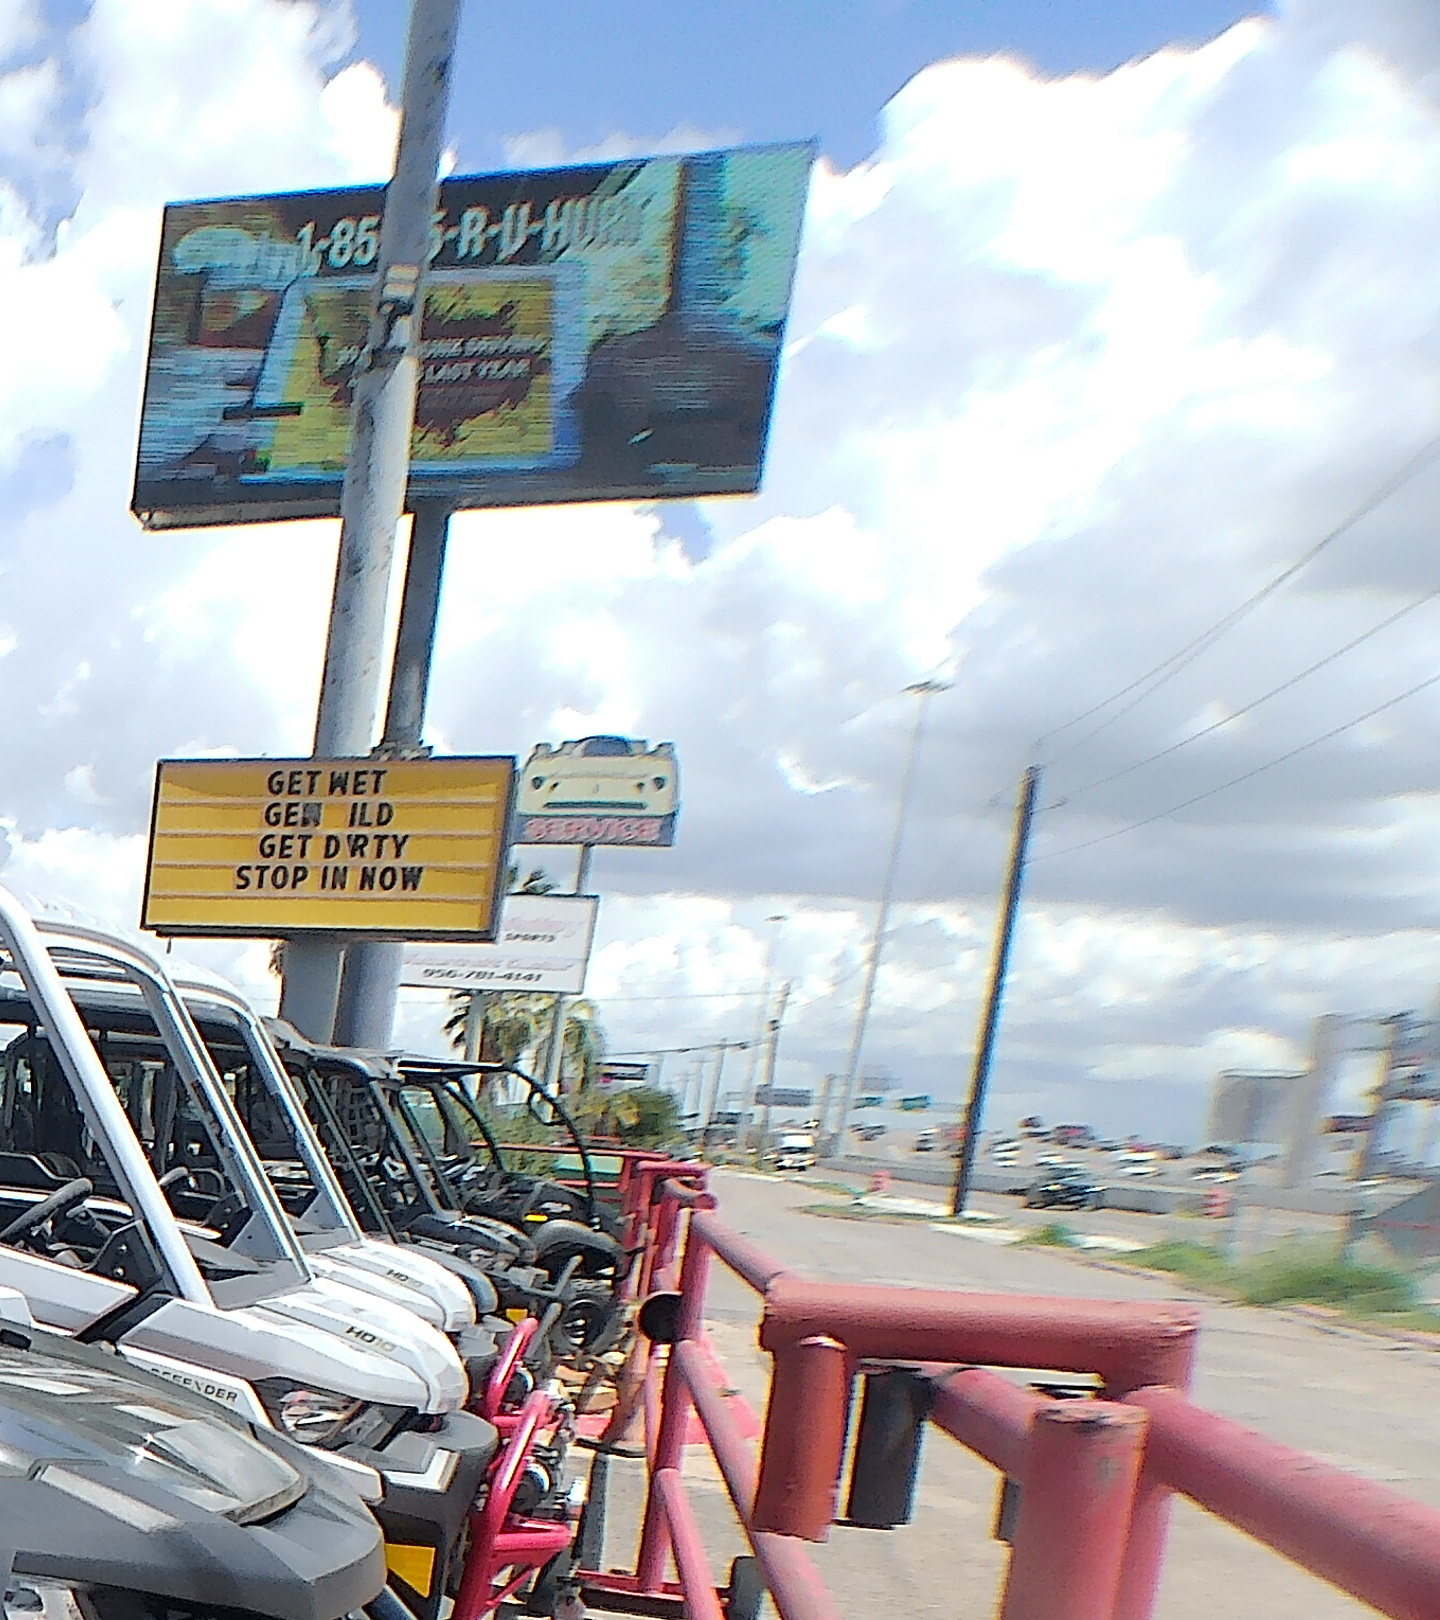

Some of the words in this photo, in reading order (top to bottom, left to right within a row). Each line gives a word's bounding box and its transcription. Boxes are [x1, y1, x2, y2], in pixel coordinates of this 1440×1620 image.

[267, 770, 322, 795] GET
[328, 770, 388, 795] WET
[259, 834, 313, 859] GET
[235, 865, 309, 890] STOP
[321, 866, 349, 890] IN
[359, 866, 424, 891] NOW
